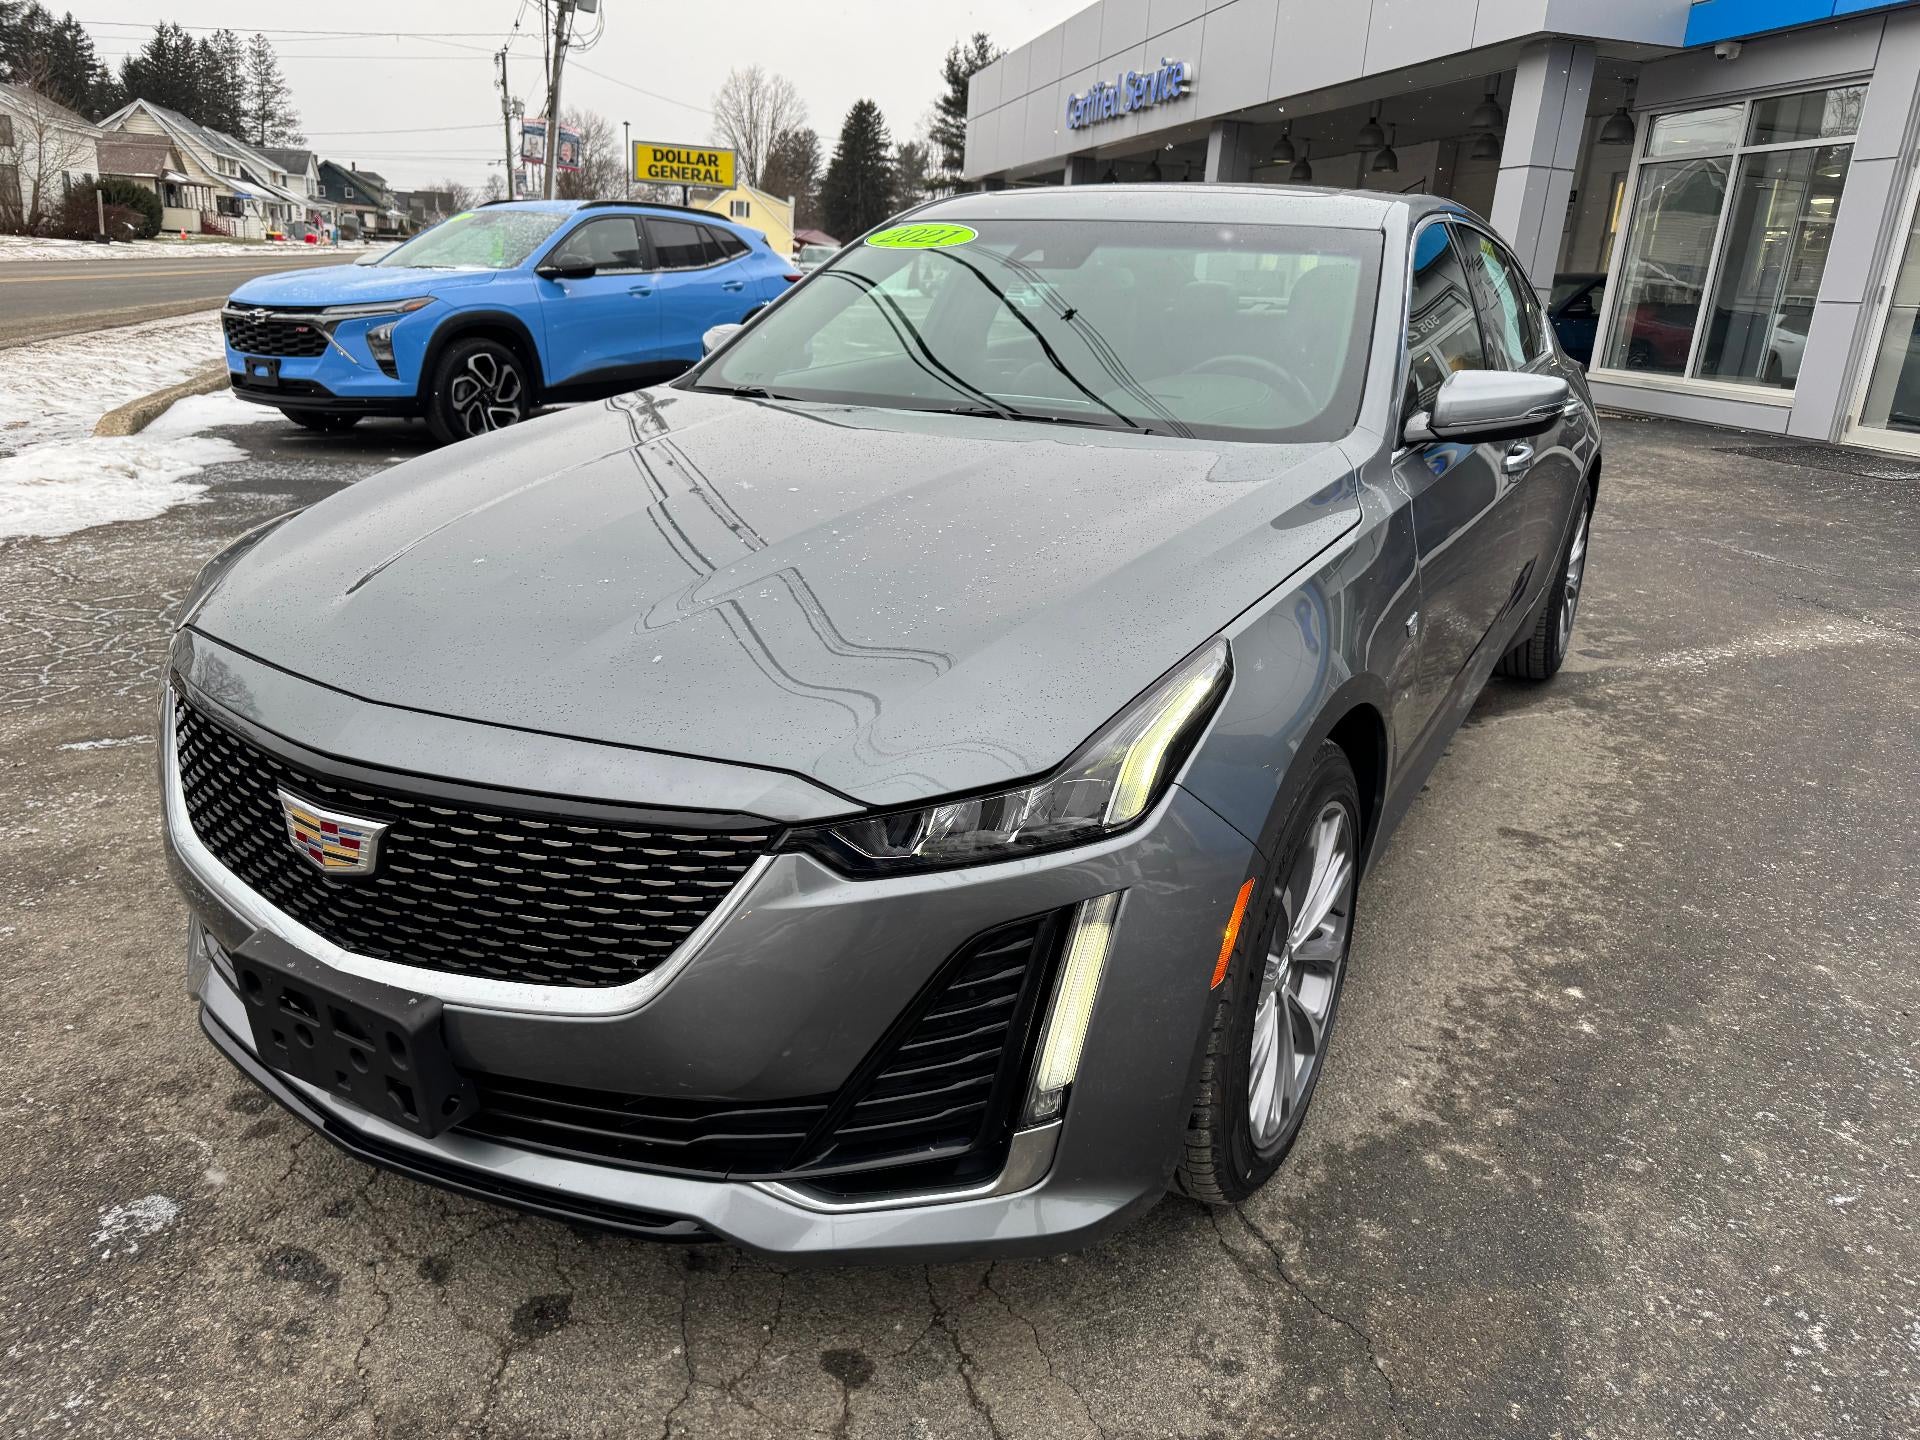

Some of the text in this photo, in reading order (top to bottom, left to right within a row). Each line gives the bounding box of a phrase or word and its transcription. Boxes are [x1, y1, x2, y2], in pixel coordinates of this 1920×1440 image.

[1066, 57, 1187, 129] Certified Service
[652, 148, 719, 167] DOLLAR
[648, 164, 723, 183] GENERAL
[877, 229, 964, 243] 2021
